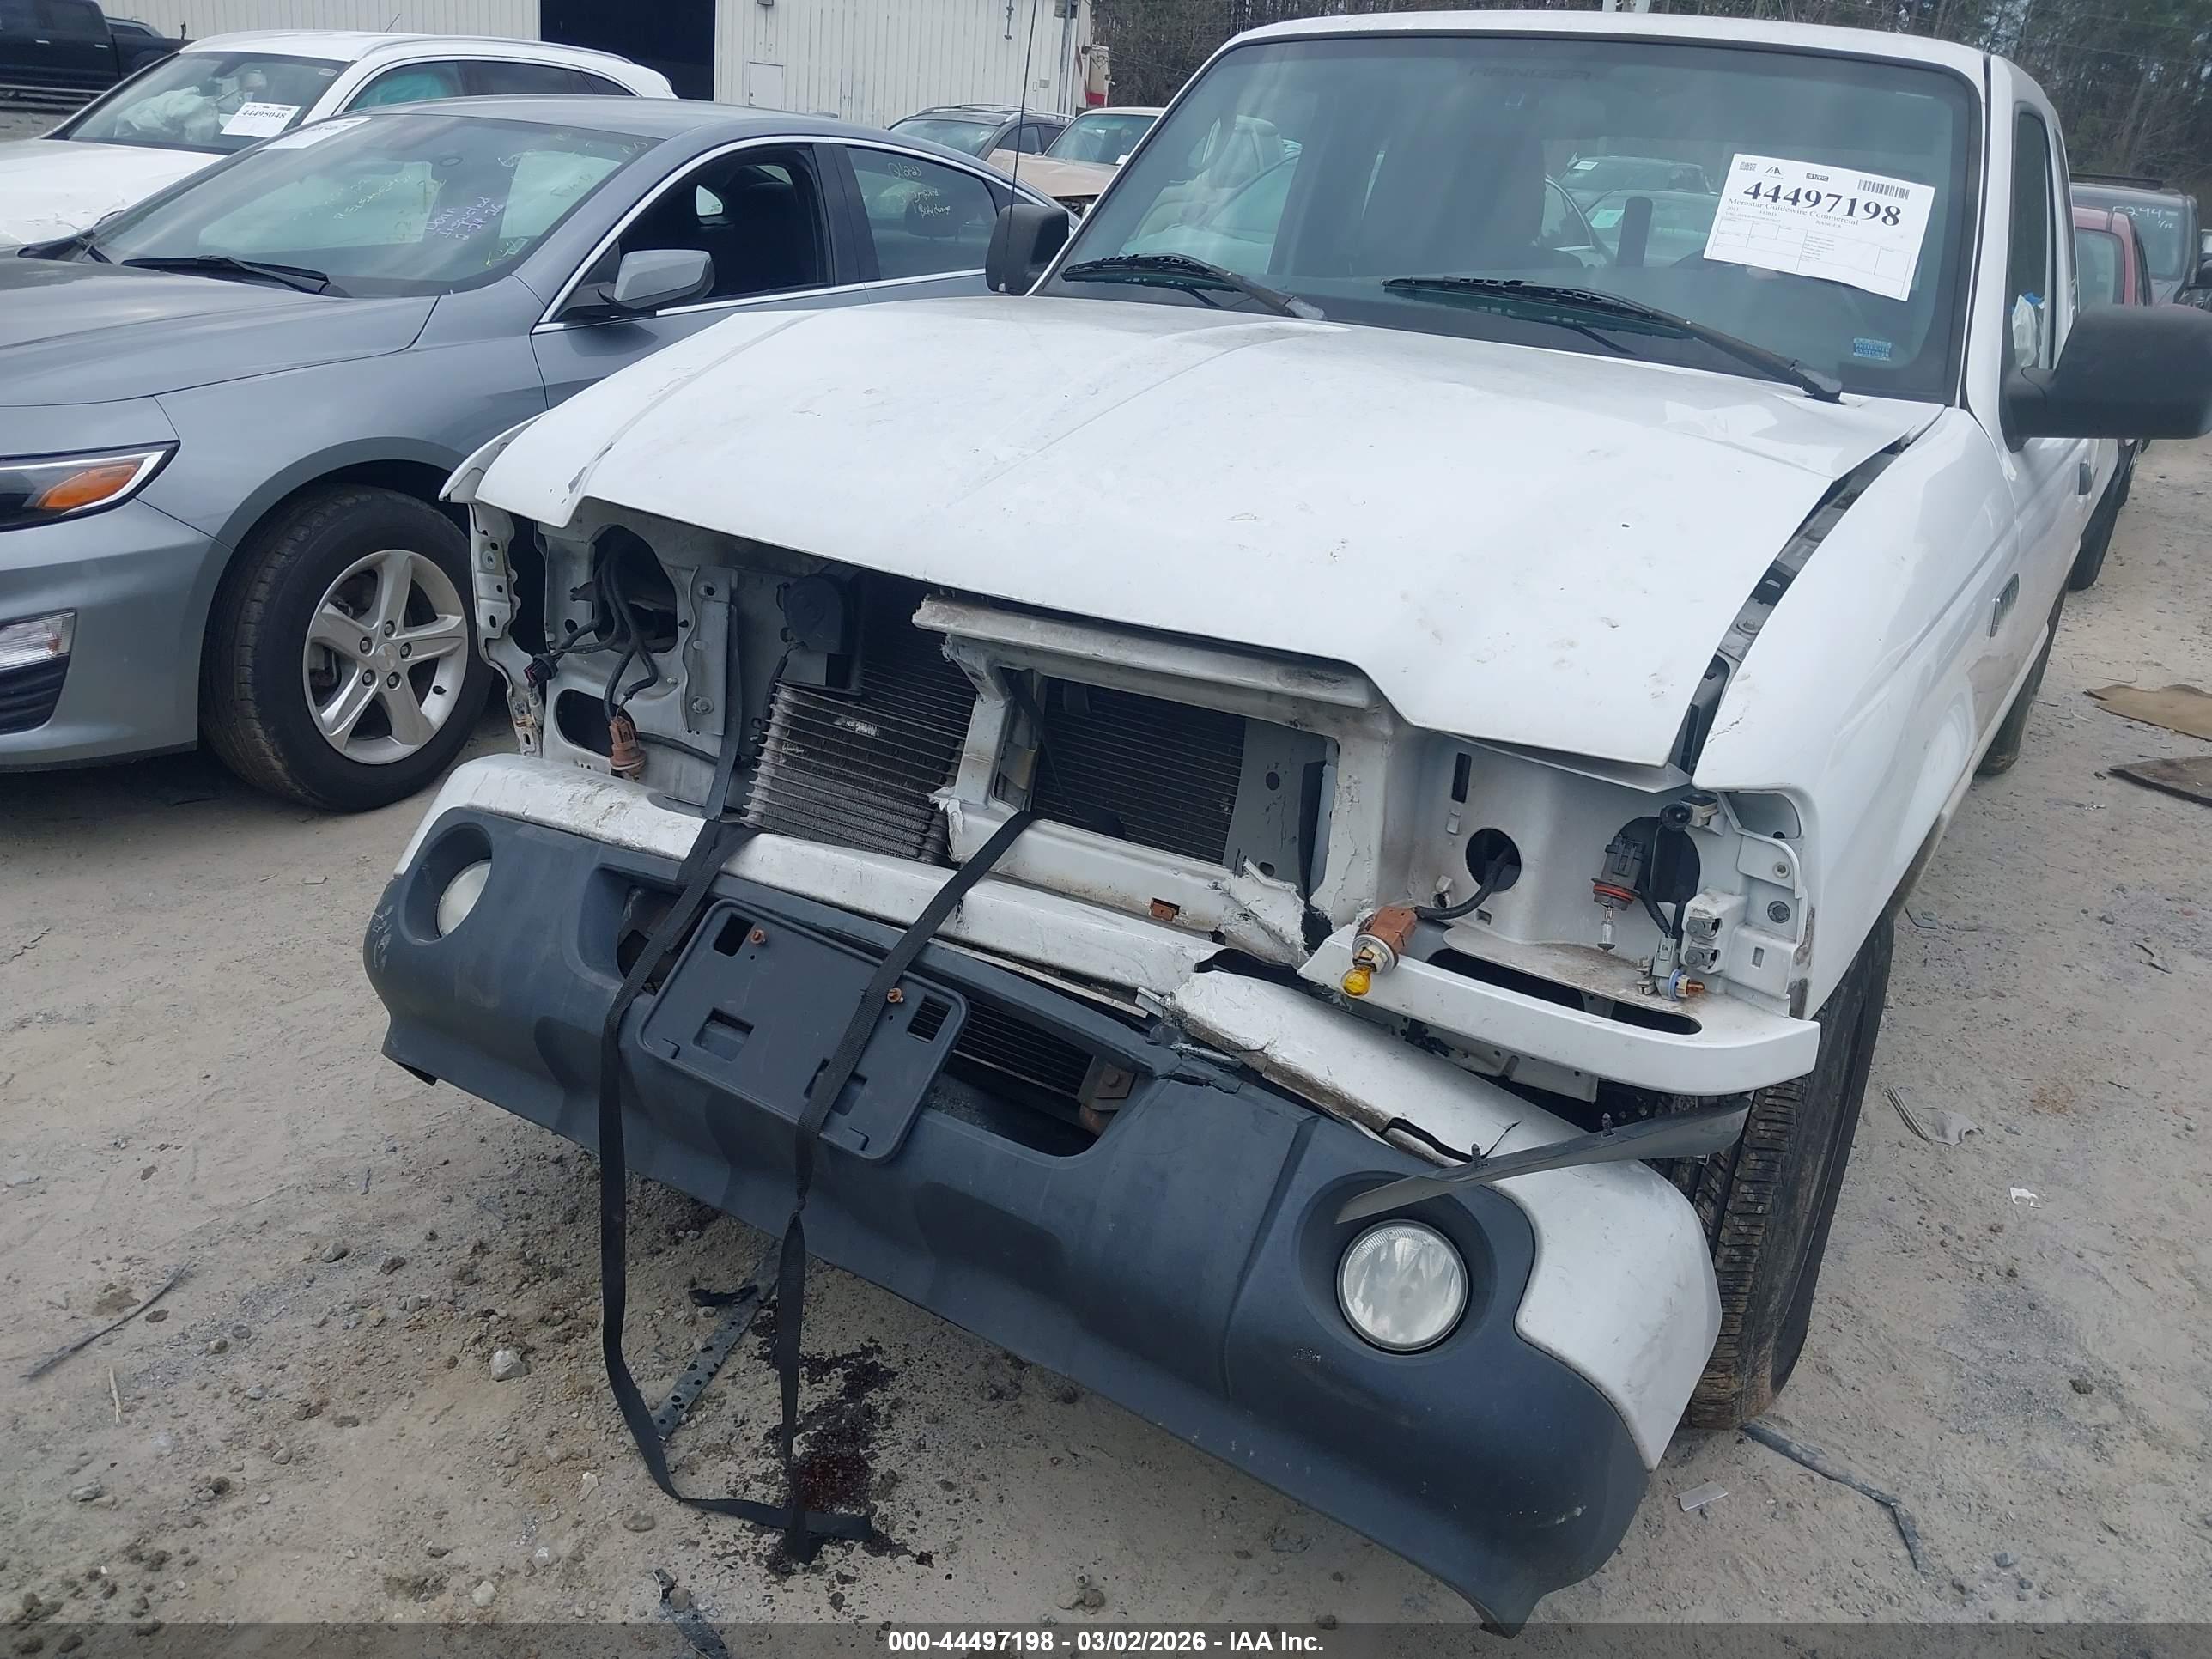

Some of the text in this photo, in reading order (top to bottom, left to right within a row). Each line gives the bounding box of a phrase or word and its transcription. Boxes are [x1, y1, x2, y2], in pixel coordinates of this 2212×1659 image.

[1729, 198, 1859, 226] Merastar Guidewire Commercial
[1743, 181, 1901, 227] 44497198
